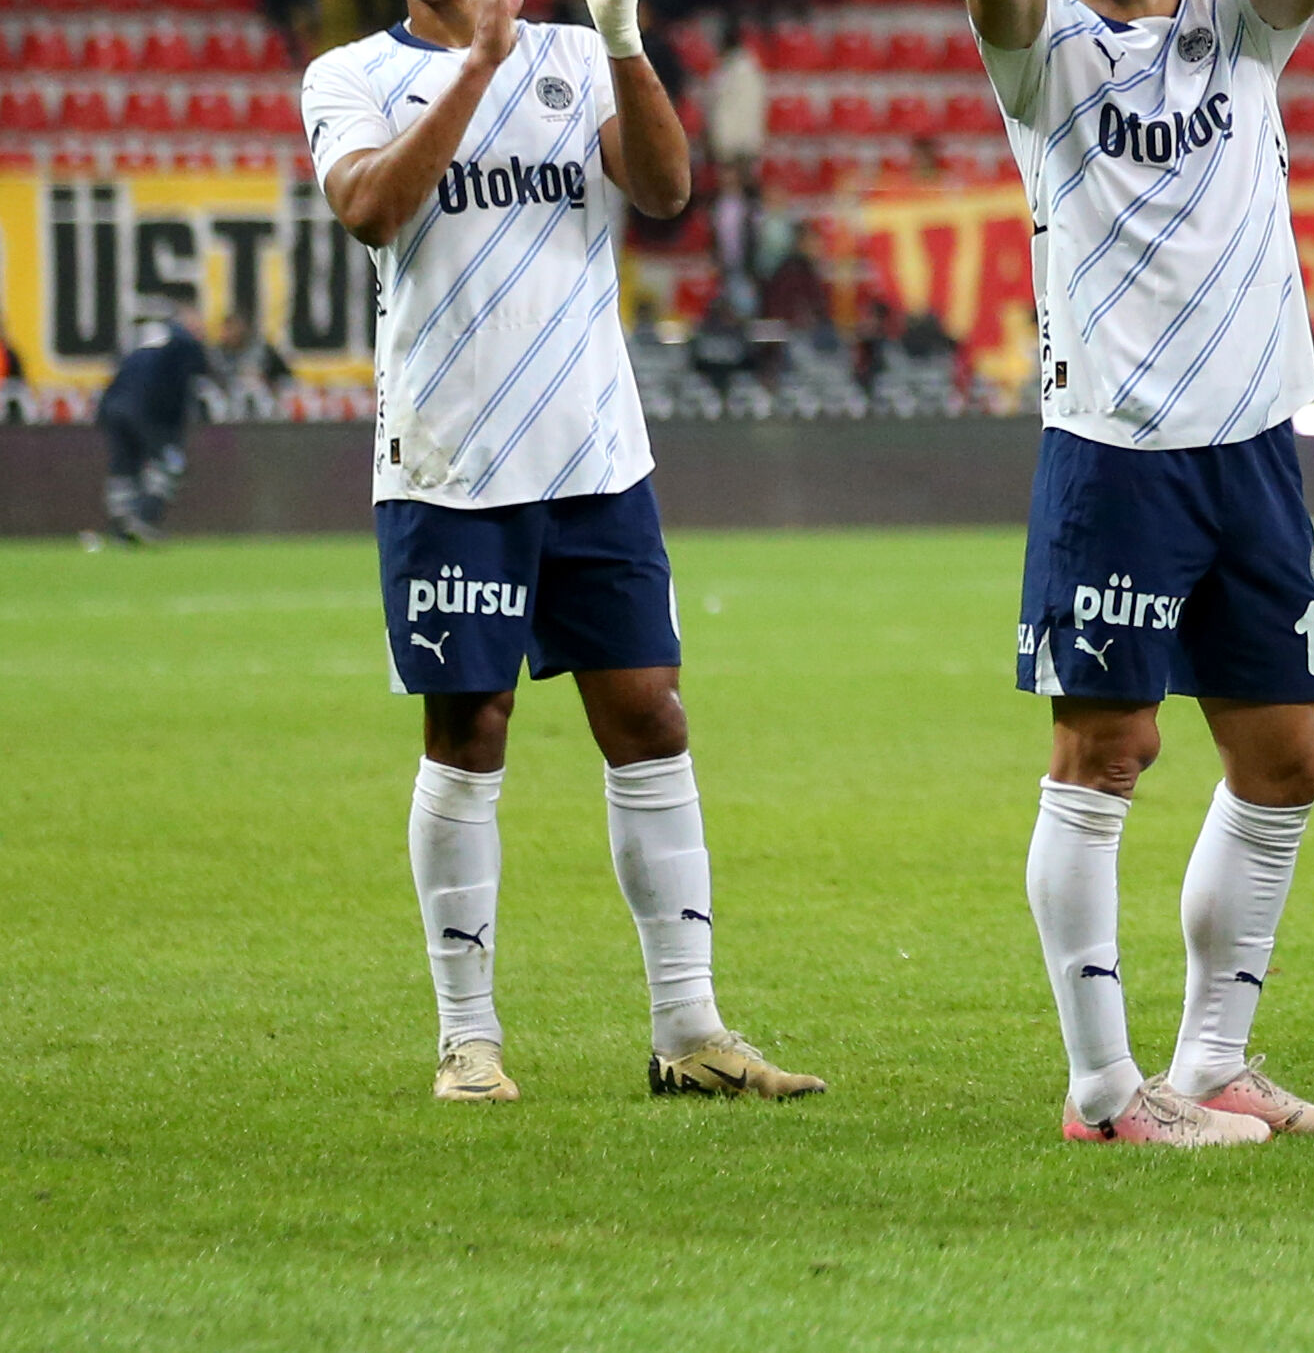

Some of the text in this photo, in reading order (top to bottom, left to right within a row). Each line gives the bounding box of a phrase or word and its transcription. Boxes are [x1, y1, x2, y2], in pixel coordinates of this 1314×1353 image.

[437, 156, 584, 215] Otokoç
[50, 182, 376, 358] ÜSTÜ
[407, 565, 528, 622] pürsu
[1073, 573, 1186, 630] pürsu
